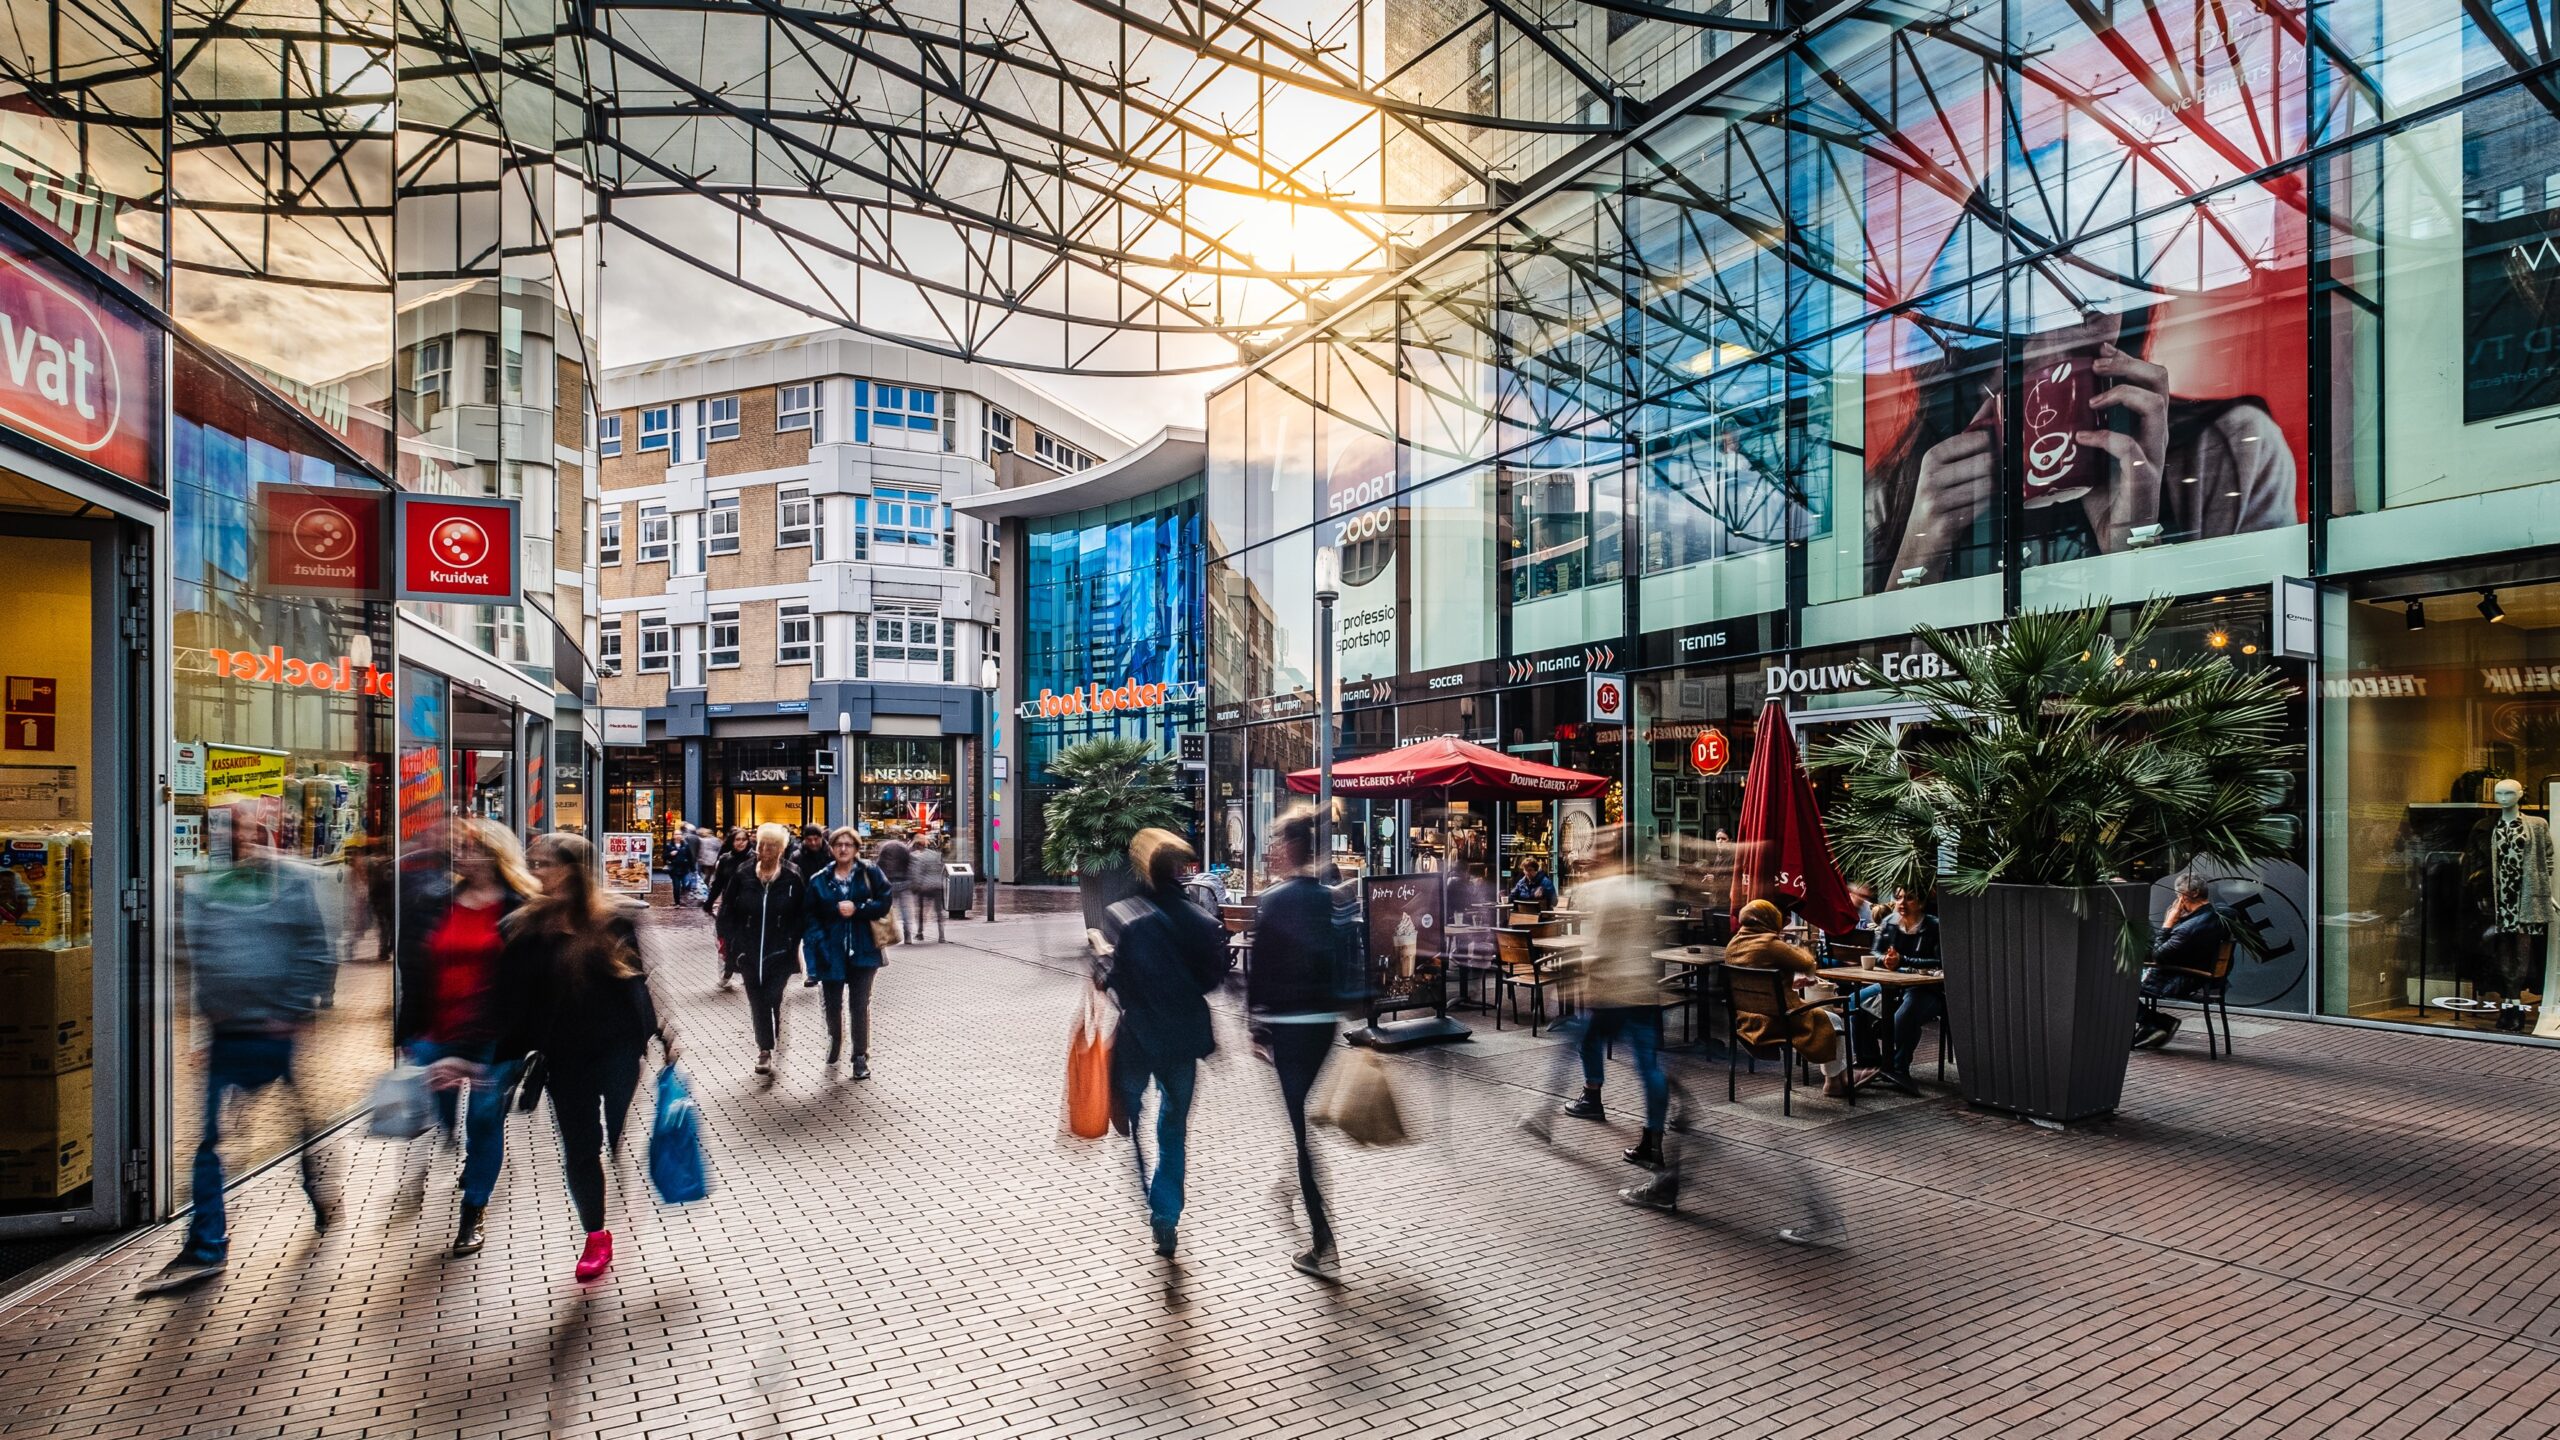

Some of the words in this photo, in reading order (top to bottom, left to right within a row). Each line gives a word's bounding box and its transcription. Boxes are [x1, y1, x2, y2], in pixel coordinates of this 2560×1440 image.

[0, 311, 95, 420] vat
[1329, 470, 1396, 517] SPORT
[1335, 506, 1391, 548] 2000
[430, 570, 488, 585] Kruidvat
[1335, 628, 1391, 656] sportshop
[1679, 632, 1727, 652] TENNIS
[1536, 655, 1581, 673] INGANG
[1429, 674, 1463, 689] SOCCER
[1090, 676, 1168, 713] Locker
[1340, 688, 1370, 702] INGANG
[1216, 710, 1240, 721] RUNNING
[211, 755, 261, 771] KASSAKORTING
[212, 776, 226, 786] met
[226, 772, 243, 787] jouw
[740, 768, 788, 782] NELSON
[875, 767, 937, 781] NELSON
[1360, 775, 1395, 787] EGBERTS
[1397, 769, 1416, 788] Café
[1540, 777, 1566, 791] EGBERTS
[1397, 884, 1416, 901] Chai
